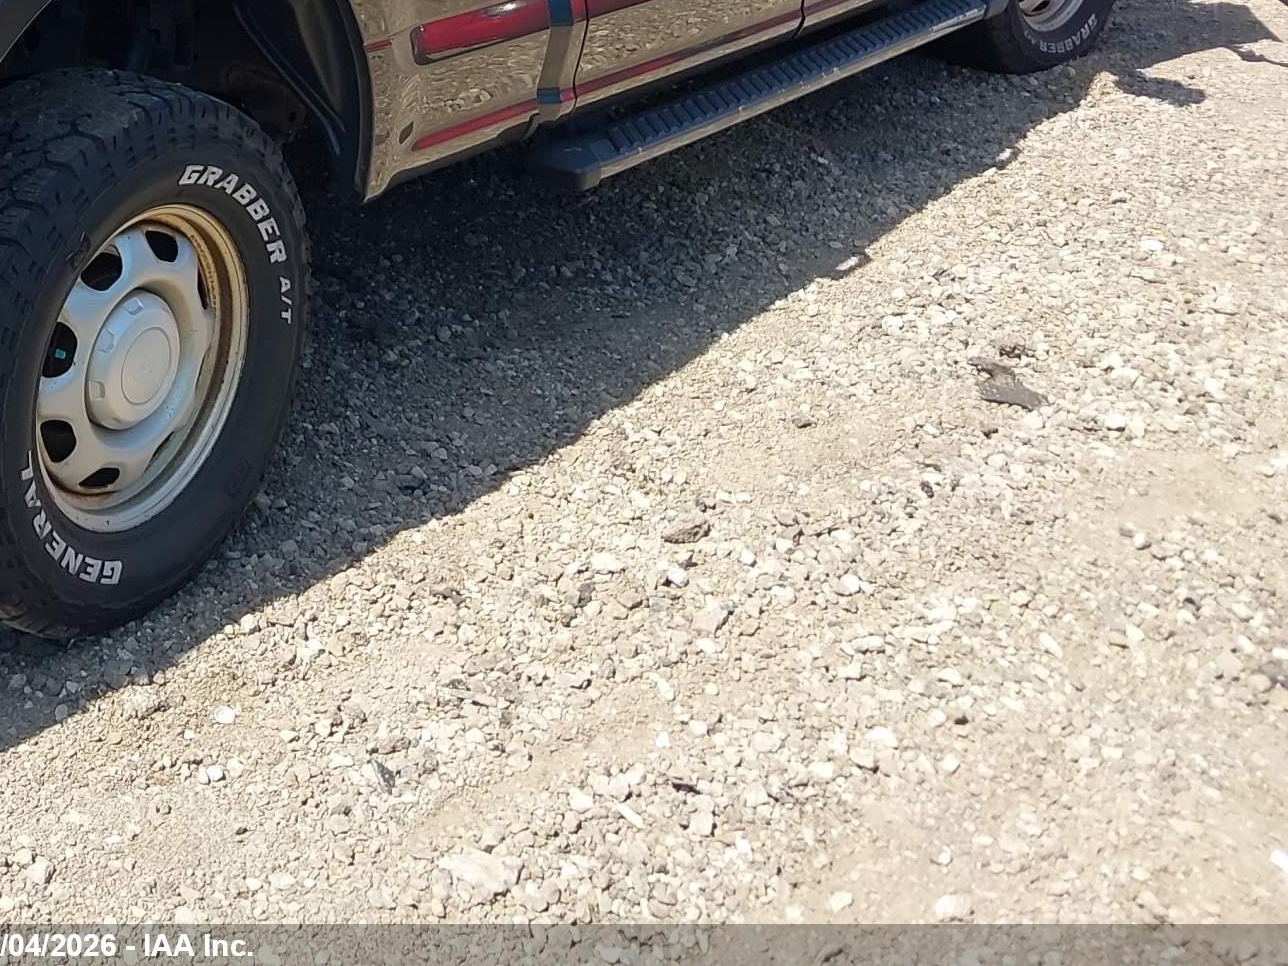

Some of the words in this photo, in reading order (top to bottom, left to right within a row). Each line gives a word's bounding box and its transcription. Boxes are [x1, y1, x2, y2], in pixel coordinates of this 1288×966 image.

[178, 164, 288, 264] GRABBER
[279, 276, 292, 324] A/T
[21, 450, 123, 585] GENERAL
